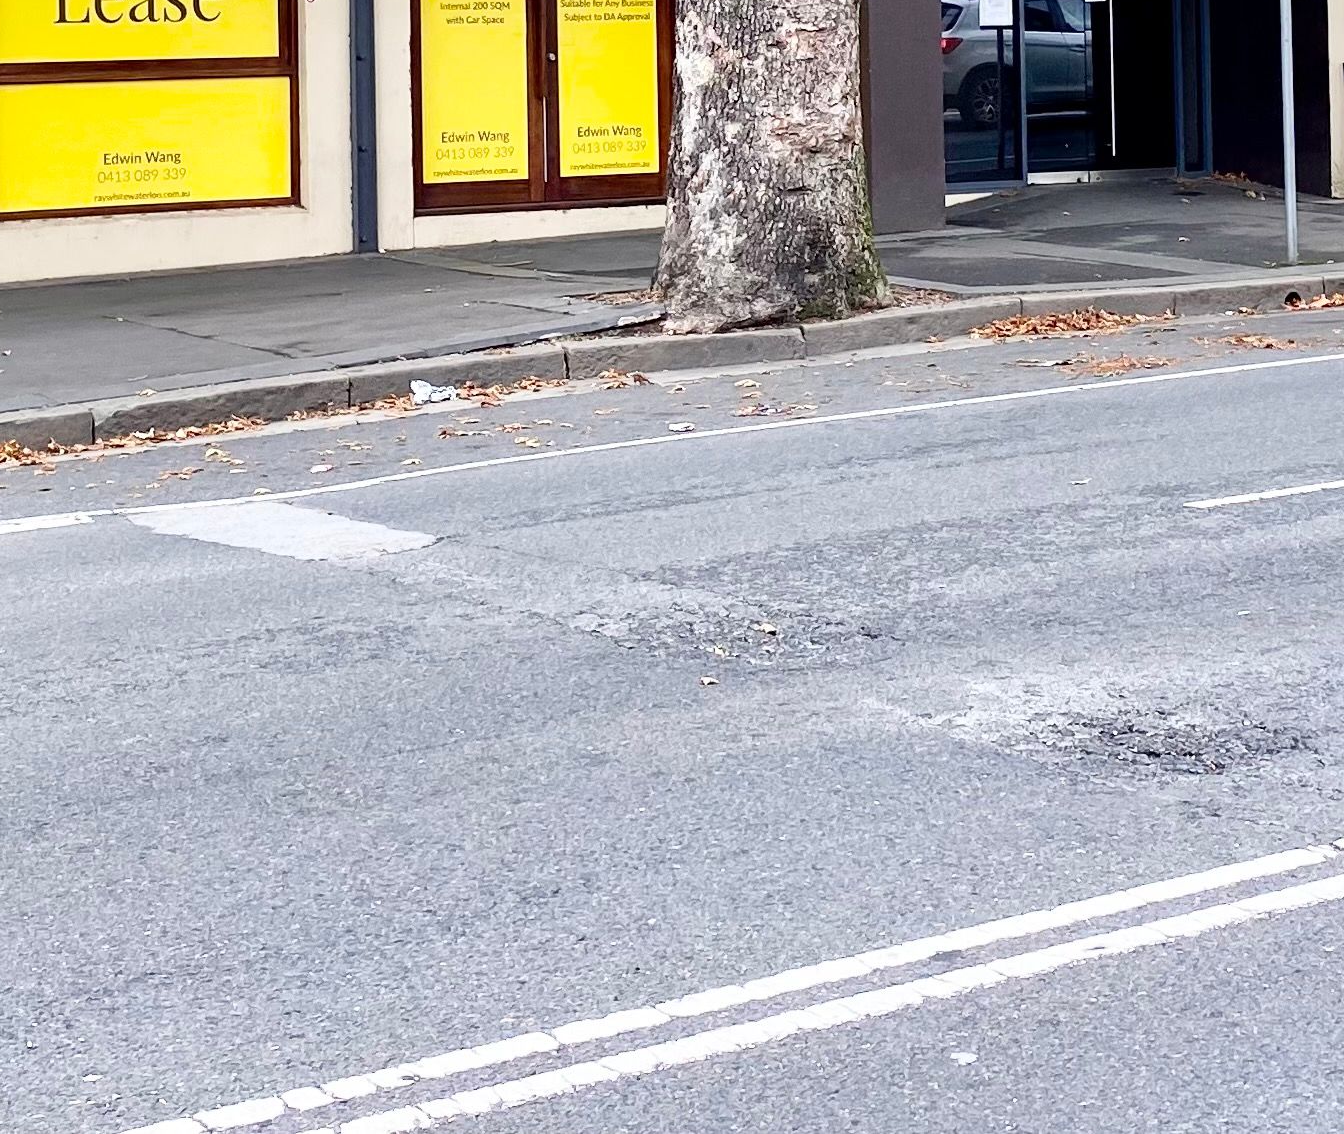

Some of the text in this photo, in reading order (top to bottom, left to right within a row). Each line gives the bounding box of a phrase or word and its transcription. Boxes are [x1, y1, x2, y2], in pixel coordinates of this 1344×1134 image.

[439, 1, 510, 11] Internal 200 SQM
[446, 15, 505, 25] with Car Space
[564, 13, 592, 22] Subject
[594, 13, 603, 21] to
[617, 12, 651, 22] Approval
[441, 130, 510, 143] Edwin Wang
[577, 125, 642, 138] Edwin Wang
[436, 146, 515, 160] 0413 089 339
[572, 140, 647, 154] 0413 089 339
[103, 150, 181, 165] Edwin Wang
[97, 167, 187, 183] 0413 089 339
